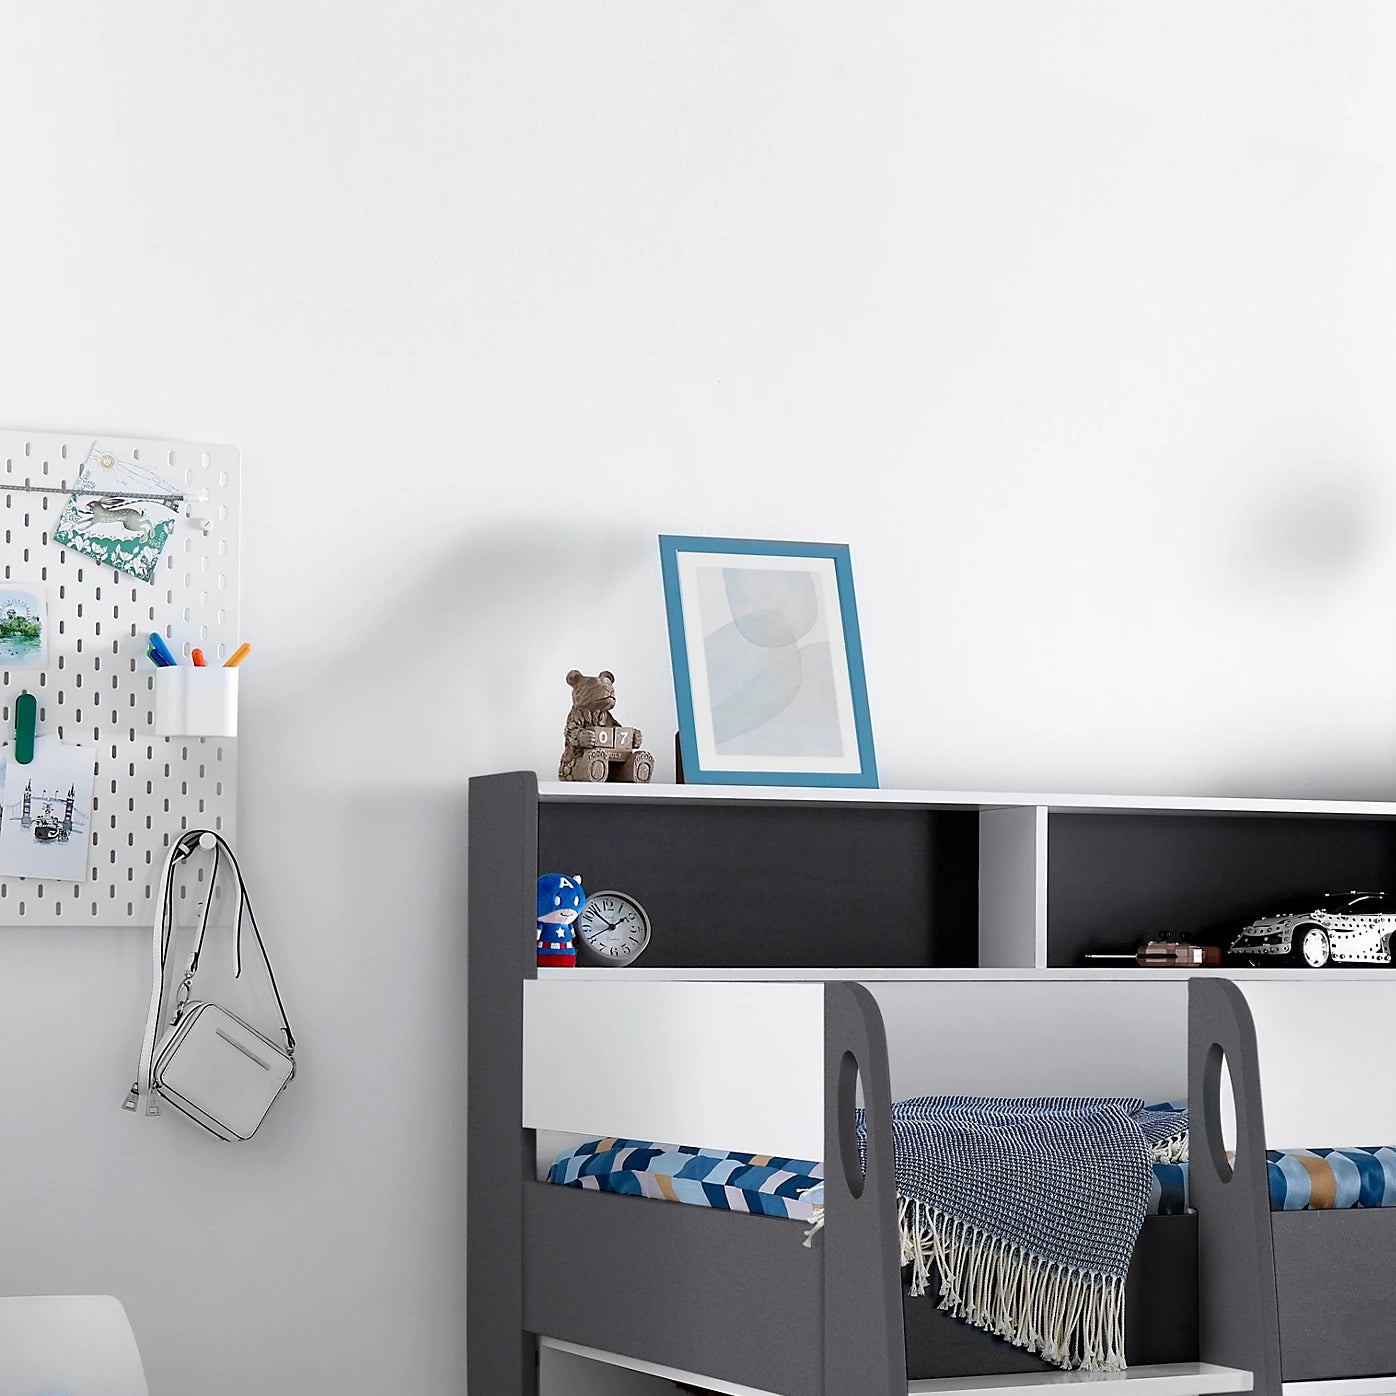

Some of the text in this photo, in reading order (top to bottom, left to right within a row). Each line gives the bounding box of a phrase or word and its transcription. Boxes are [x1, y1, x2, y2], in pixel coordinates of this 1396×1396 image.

[559, 876, 575, 889] A
[602, 900, 614, 911] 12
[610, 946, 618, 956] 6
[621, 943, 631, 953] 5
